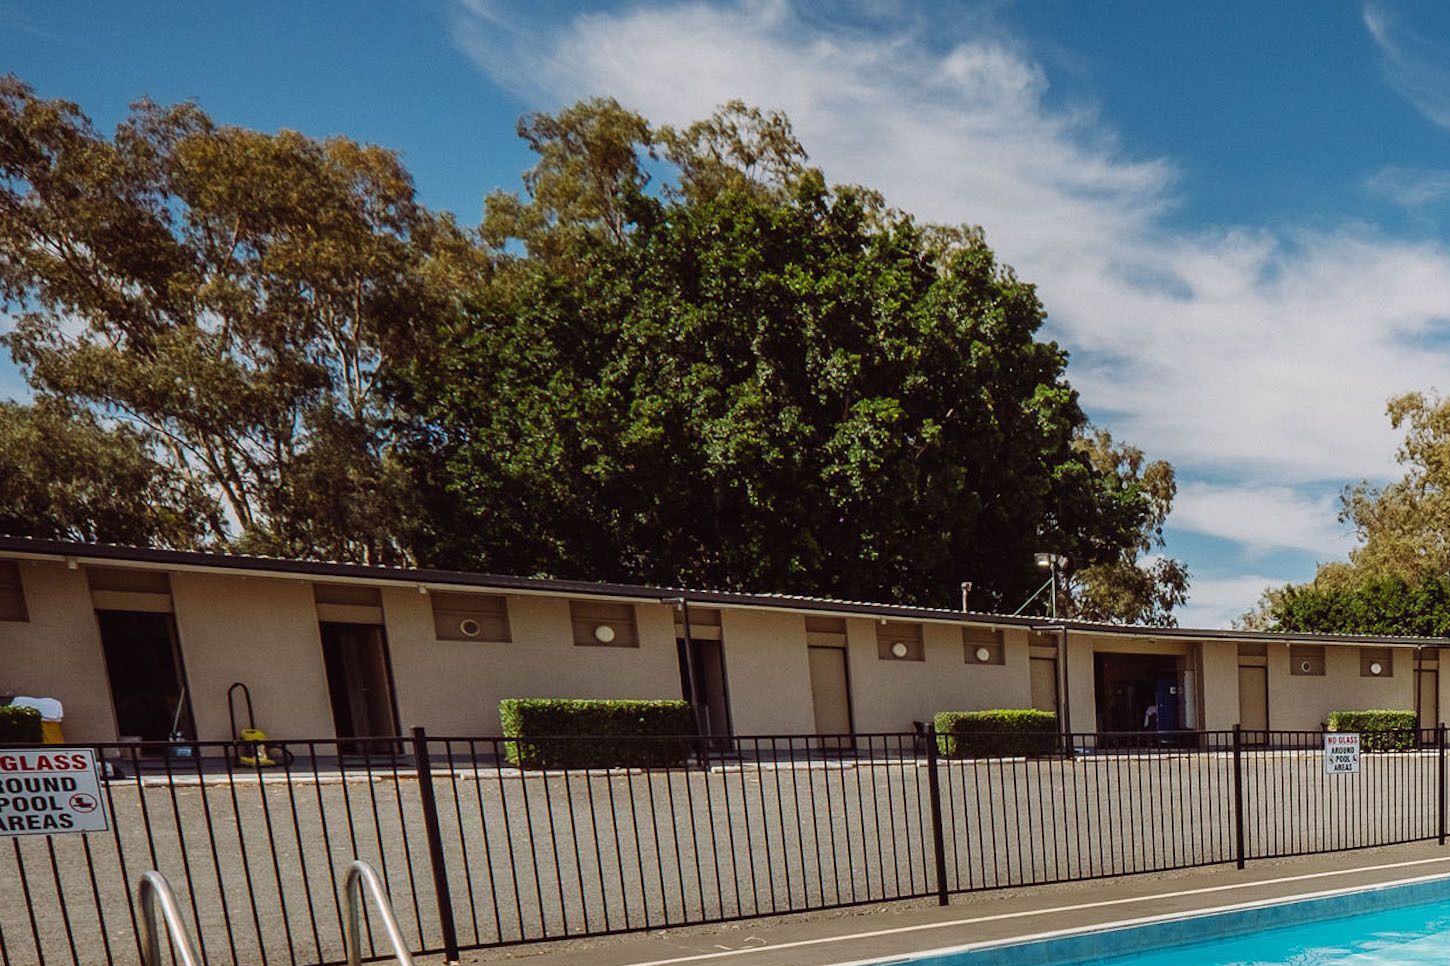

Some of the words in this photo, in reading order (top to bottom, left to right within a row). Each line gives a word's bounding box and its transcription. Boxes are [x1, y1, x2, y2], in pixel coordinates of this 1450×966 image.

[1327, 736, 1337, 744] NO
[1338, 736, 1358, 744] GLASS
[0, 754, 88, 771] GLASS
[0, 796, 63, 812] POOL
